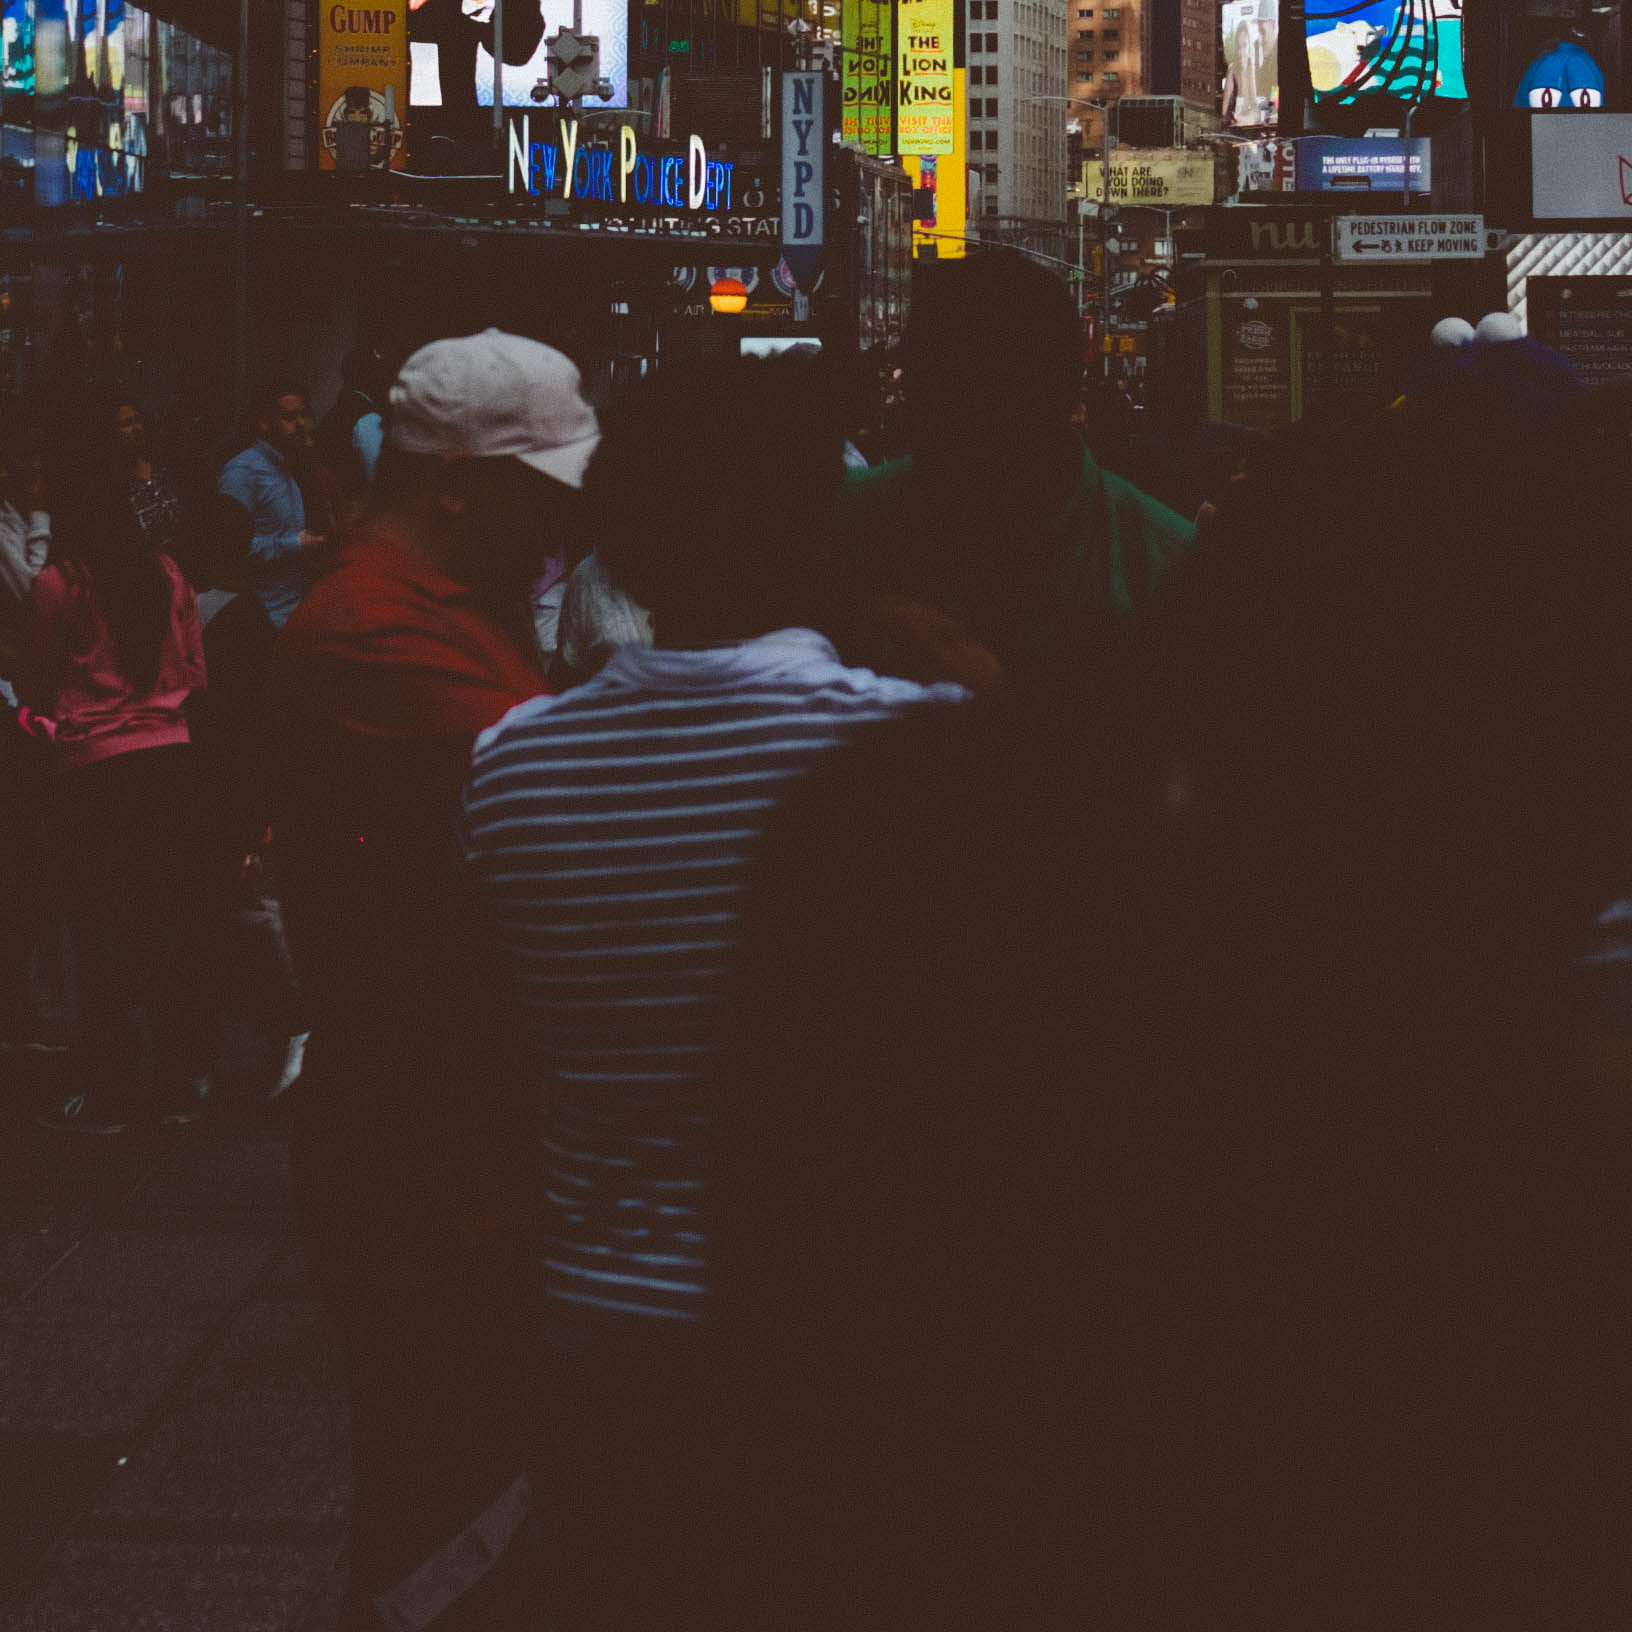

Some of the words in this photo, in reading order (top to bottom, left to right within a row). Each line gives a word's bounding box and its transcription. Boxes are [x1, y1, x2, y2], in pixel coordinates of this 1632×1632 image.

[329, 4, 397, 35] GUMP
[908, 36, 940, 49] THE
[902, 53, 947, 77] LION
[899, 79, 952, 107] KING
[620, 125, 685, 208] POLICE
[688, 134, 735, 210] DEPT
[792, 77, 814, 240] NYPD
[1132, 166, 1153, 177] ARE
[1132, 176, 1164, 187] DOING
[1096, 187, 1128, 199] DWN
[1132, 186, 1169, 198] THERE?
[727, 217, 781, 236] STAT
[1350, 220, 1415, 236] PEDESTRIAN
[1418, 219, 1447, 235] FLOW
[1450, 219, 1478, 235] ZONE
[1407, 238, 1434, 253] KEEP
[1437, 238, 1478, 253] MOVING
